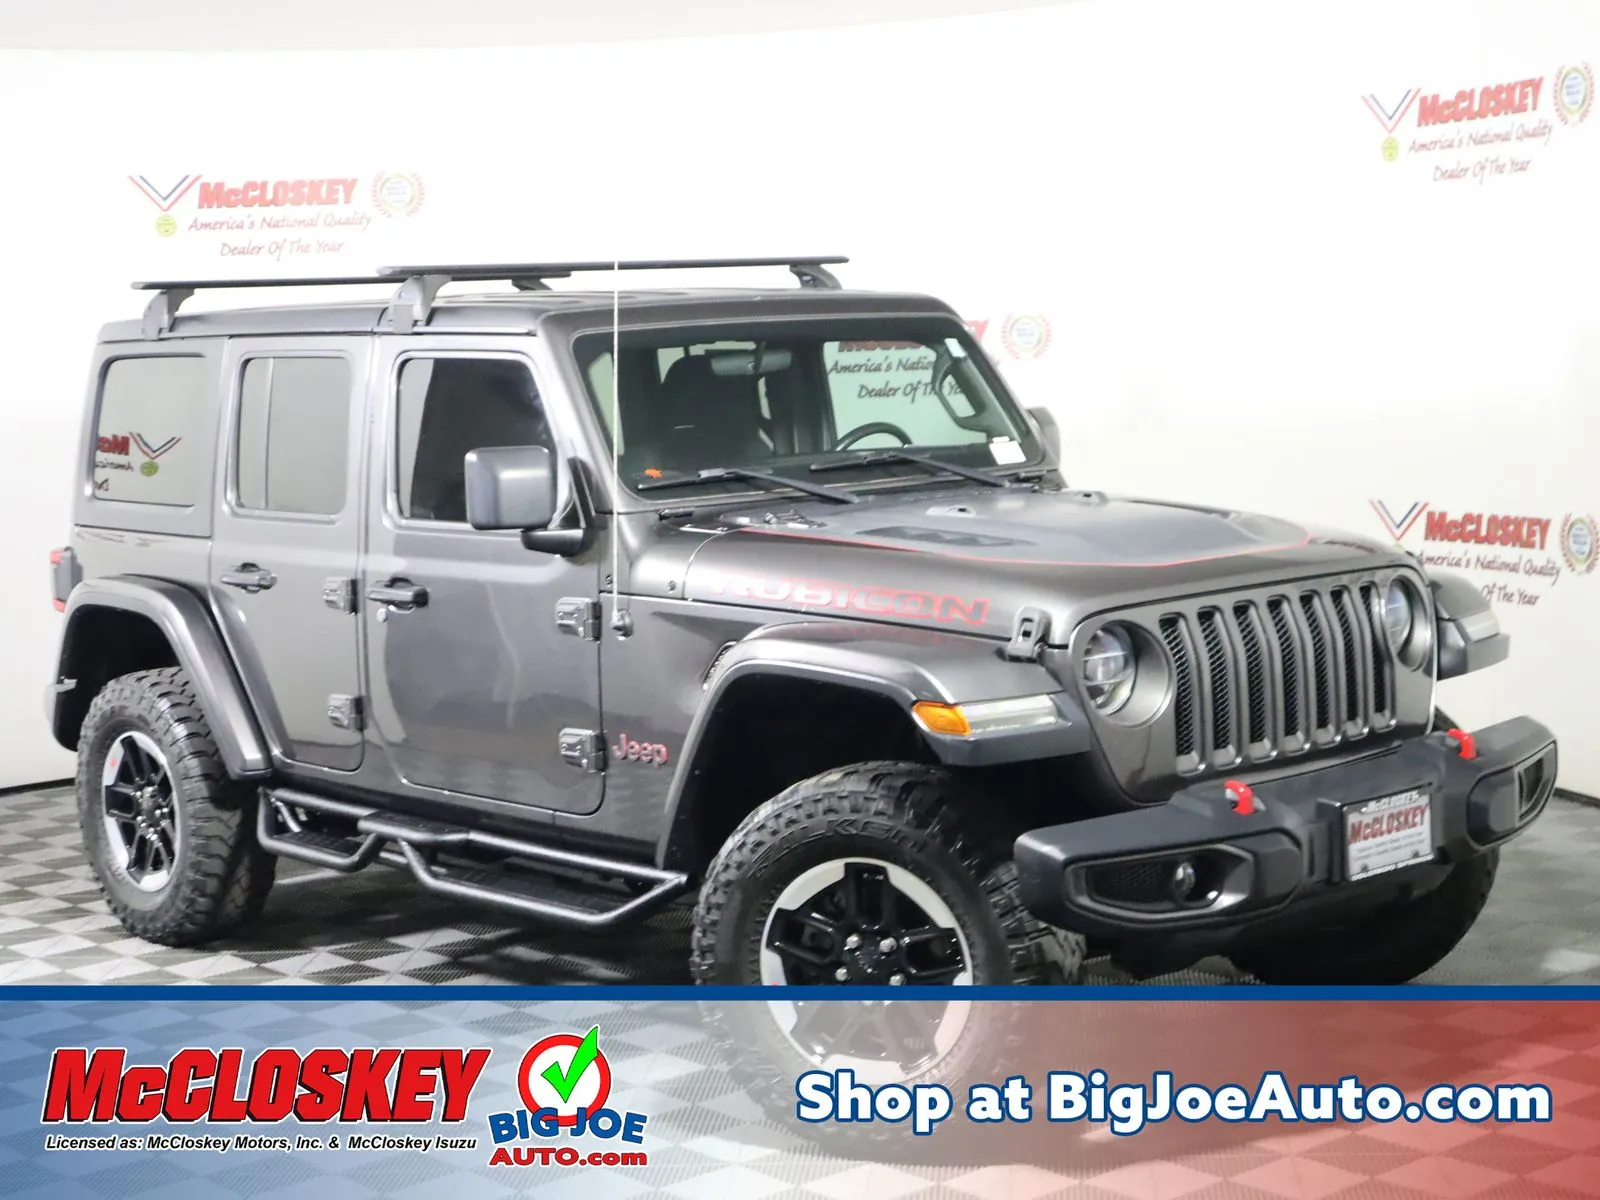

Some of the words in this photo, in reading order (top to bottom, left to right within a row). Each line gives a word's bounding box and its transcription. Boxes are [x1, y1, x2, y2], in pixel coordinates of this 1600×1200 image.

[1417, 77, 1544, 127] McCLOSKEY
[1408, 129, 1464, 154] America's
[1468, 122, 1513, 148] National
[1516, 118, 1553, 146] Quality
[1433, 161, 1470, 181] Dealer
[1473, 158, 1487, 185] Of
[1487, 156, 1506, 175] The
[1509, 157, 1532, 174] Year
[198, 178, 358, 209] McCLOSKEY
[188, 214, 256, 232] America's
[260, 212, 319, 230] National
[323, 211, 372, 232] Quality
[220, 239, 264, 257] Dealer
[268, 239, 285, 261] Of
[288, 237, 311, 254] The
[316, 239, 344, 254] Year
[828, 356, 892, 375] America's
[896, 356, 934, 372] Natio
[857, 381, 900, 399] Dealer
[903, 380, 922, 404] Of
[1424, 511, 1551, 550] McCLOSKEY
[1474, 554, 1520, 574] National
[1523, 558, 1561, 586] Quality
[709, 572, 990, 626] RUBICON
[1481, 582, 1497, 603] Of
[1497, 583, 1515, 605] The
[1517, 589, 1541, 606] Year
[612, 733, 668, 769] Jeep
[1349, 803, 1431, 846] McCLOSKEY
